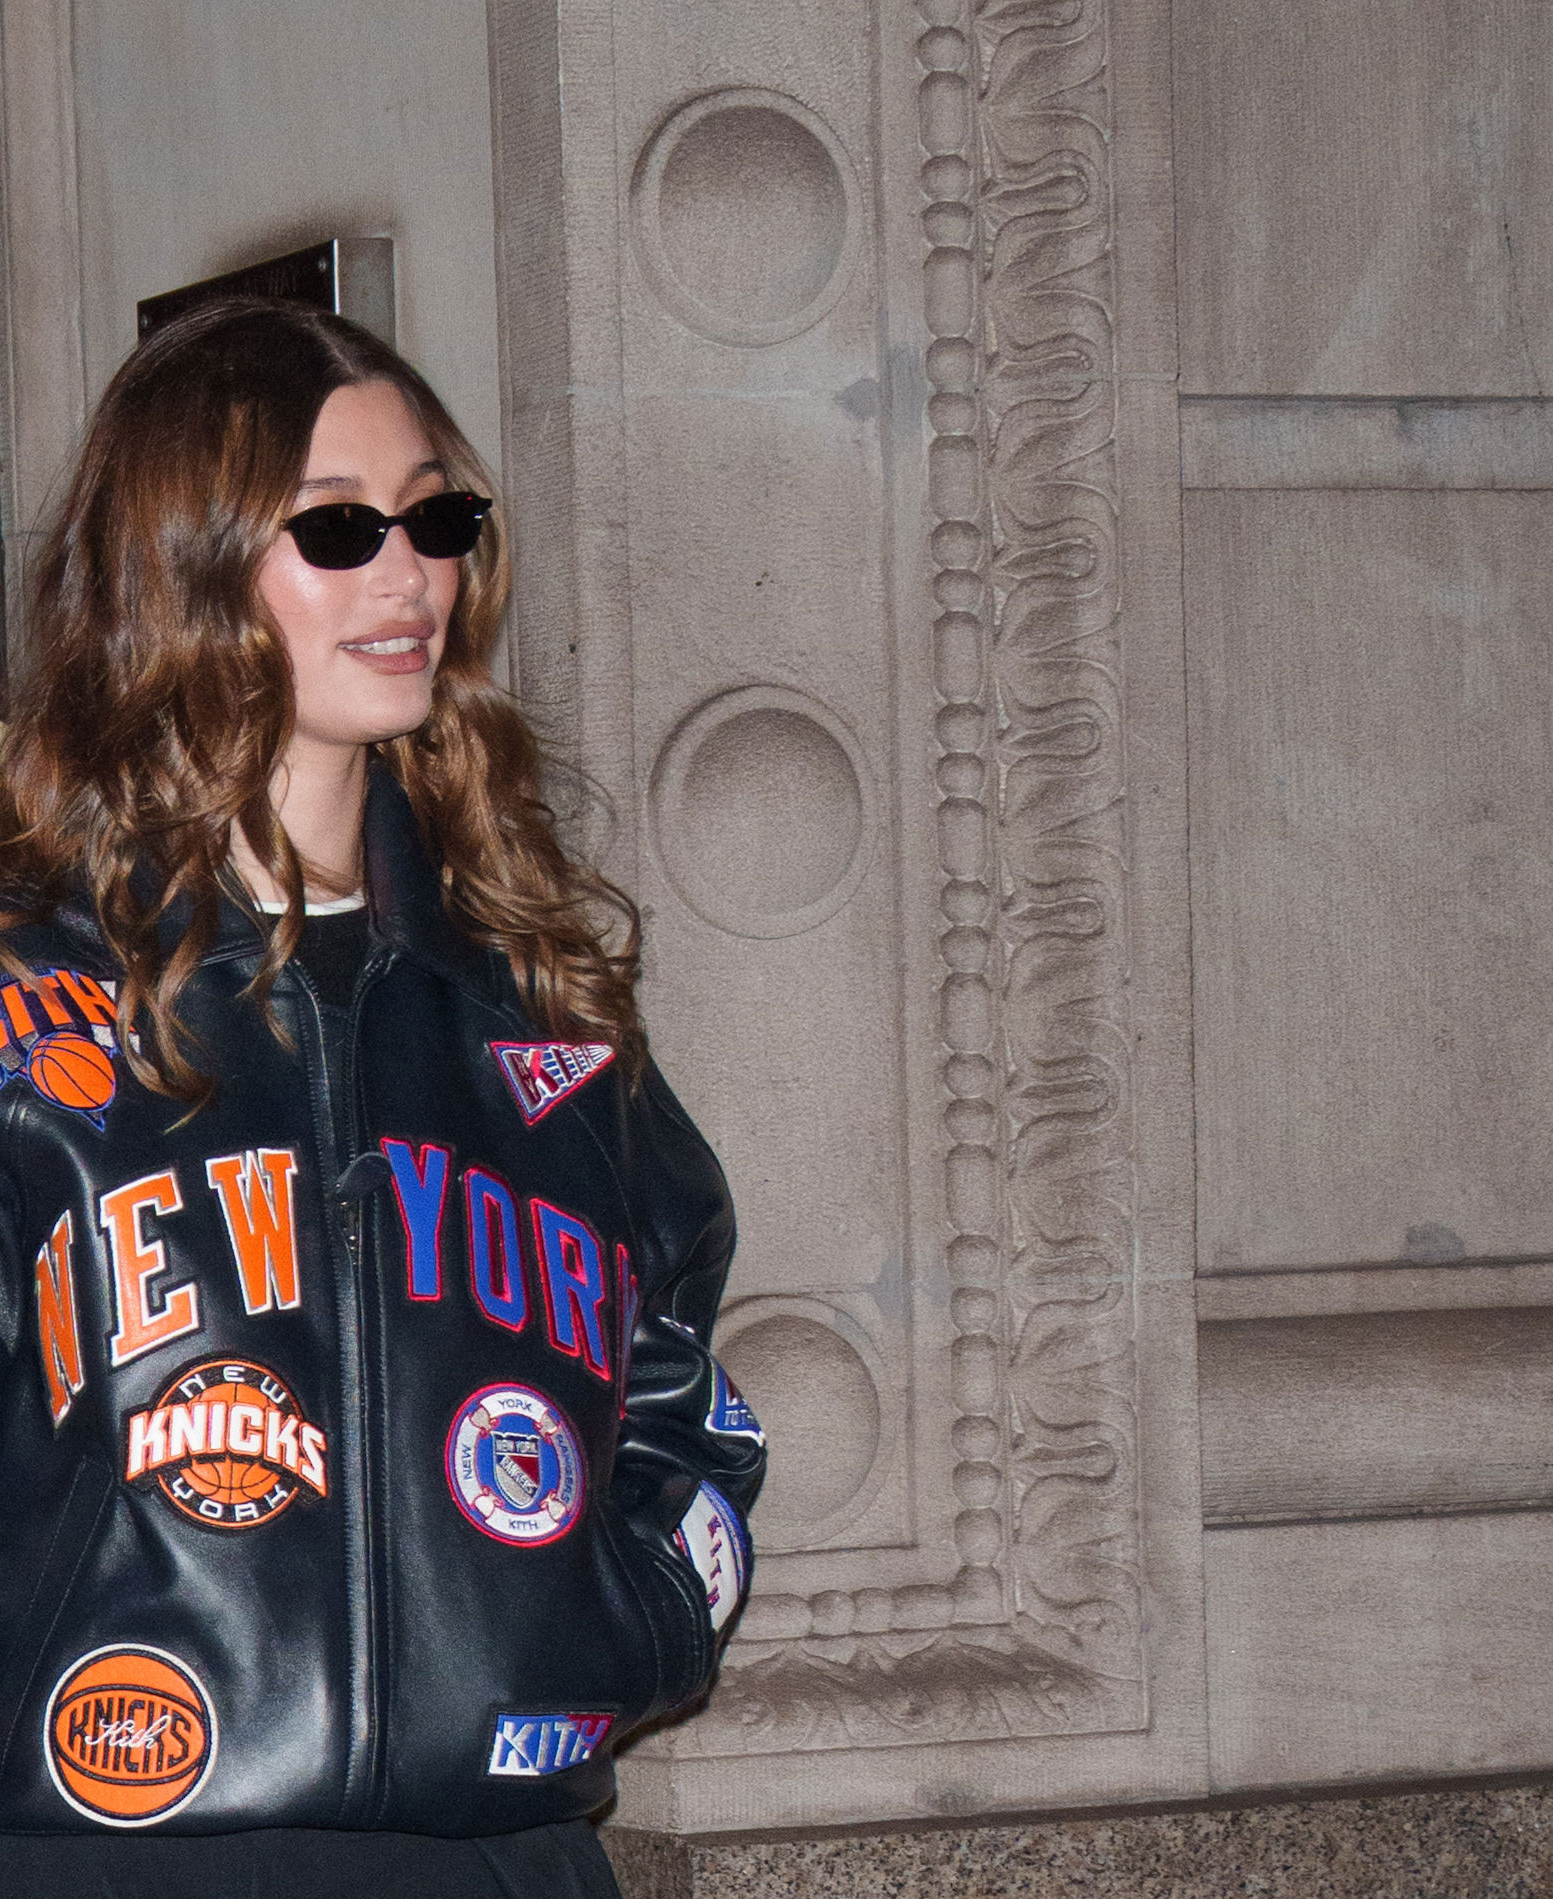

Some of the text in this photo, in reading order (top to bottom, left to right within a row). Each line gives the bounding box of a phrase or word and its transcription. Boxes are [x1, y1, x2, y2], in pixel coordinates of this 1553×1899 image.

[35, 1146, 304, 1427] NEW
[179, 1365, 287, 1403] NEW
[126, 1400, 328, 1494] KNICKS
[462, 1444, 473, 1481] NEW
[497, 1398, 534, 1413] YORK
[171, 1475, 296, 1523] YORK
[507, 1519, 539, 1532] KITH
[67, 1696, 191, 1775] KNICKS
[495, 1719, 608, 1770] KITH
